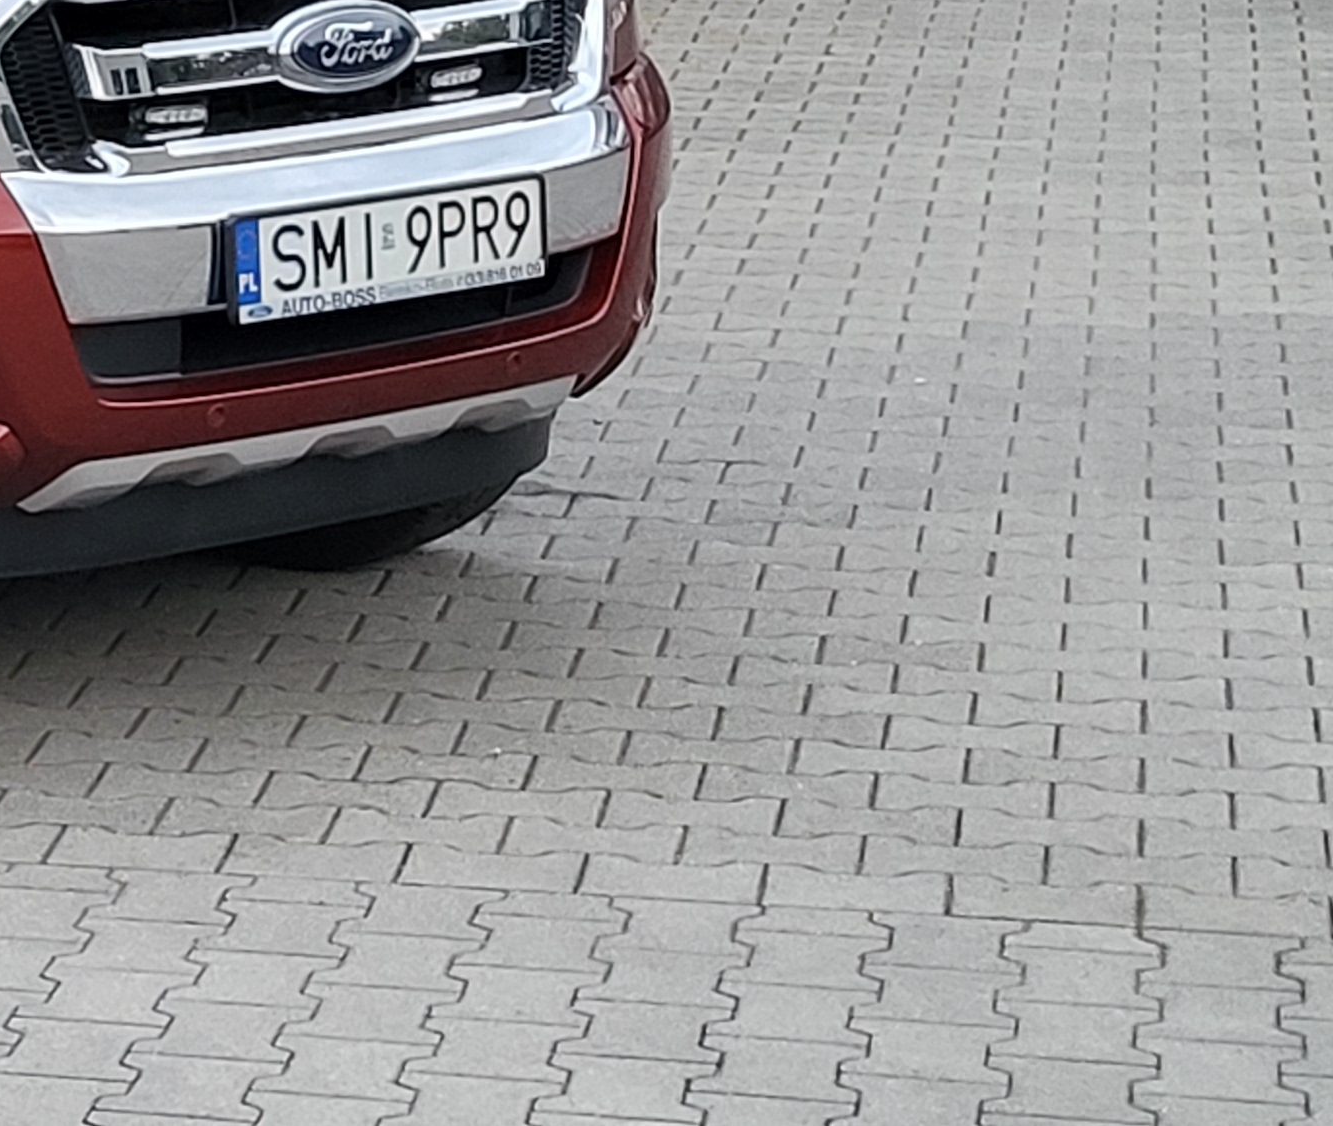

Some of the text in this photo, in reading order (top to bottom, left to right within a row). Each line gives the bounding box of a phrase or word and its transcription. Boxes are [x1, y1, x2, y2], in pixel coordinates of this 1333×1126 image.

[319, 19, 394, 68] Ford
[272, 190, 531, 292] SMI 9PR9
[239, 273, 259, 294] PL
[282, 287, 376, 315] AUTO-BOSS
